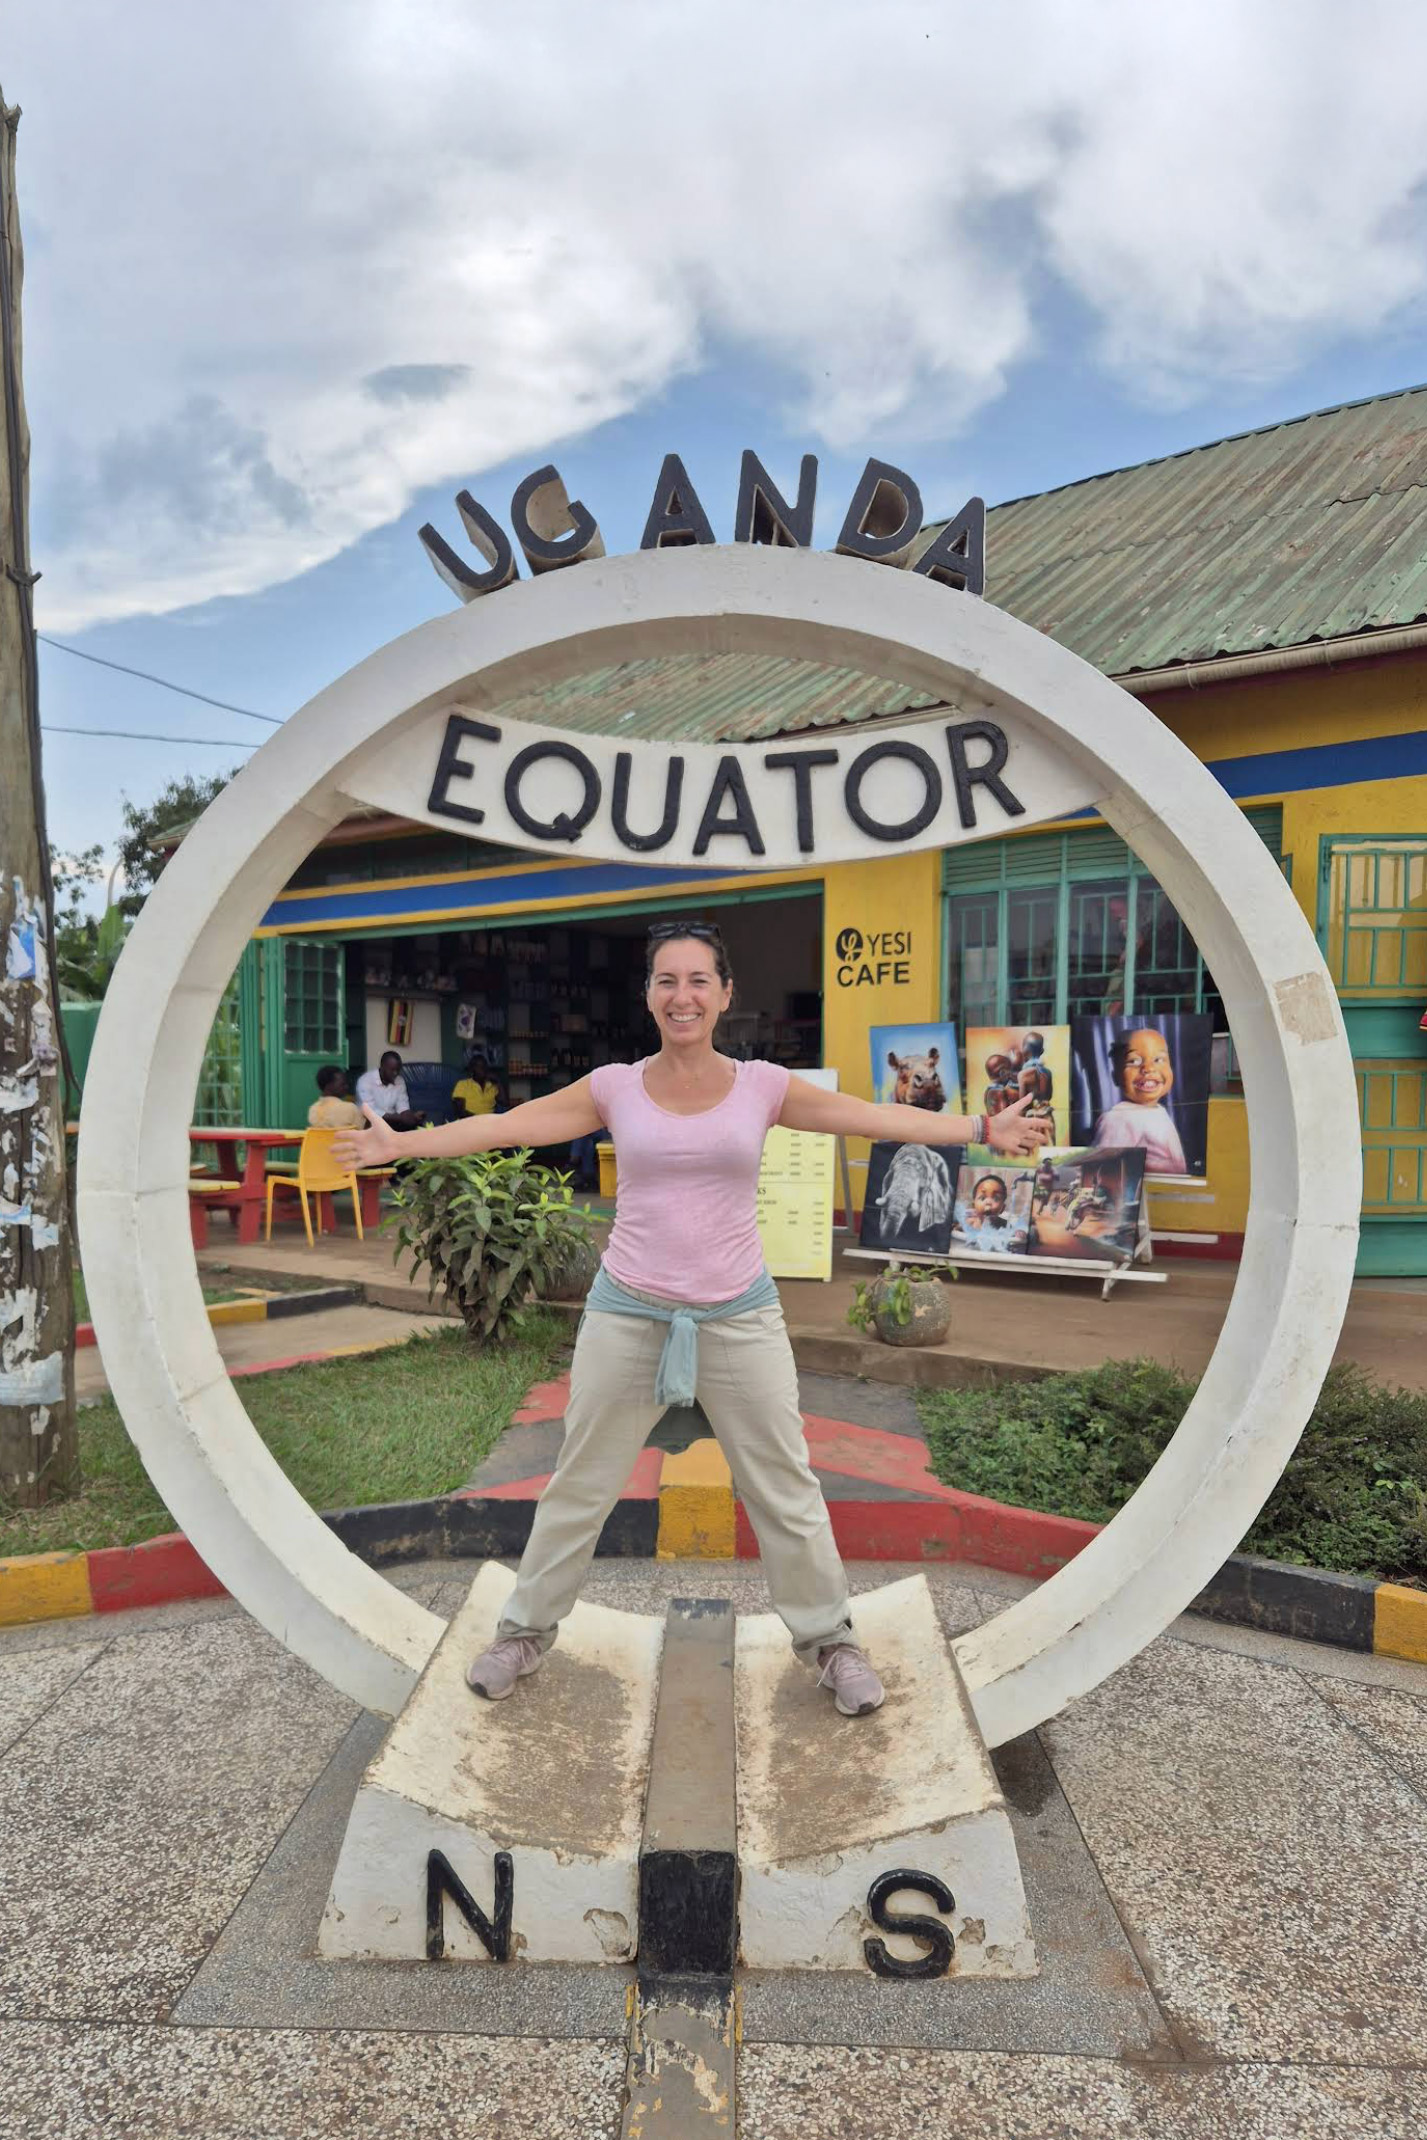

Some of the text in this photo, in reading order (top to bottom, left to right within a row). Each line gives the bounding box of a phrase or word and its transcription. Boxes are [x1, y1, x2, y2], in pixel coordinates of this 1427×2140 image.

[418, 449, 986, 596] UGANDA
[427, 715, 1026, 856] EQUATOR
[837, 961, 910, 987] CAFE
[866, 931, 912, 956] YESI
[426, 1848, 514, 1963] N
[864, 1868, 956, 1979] S
